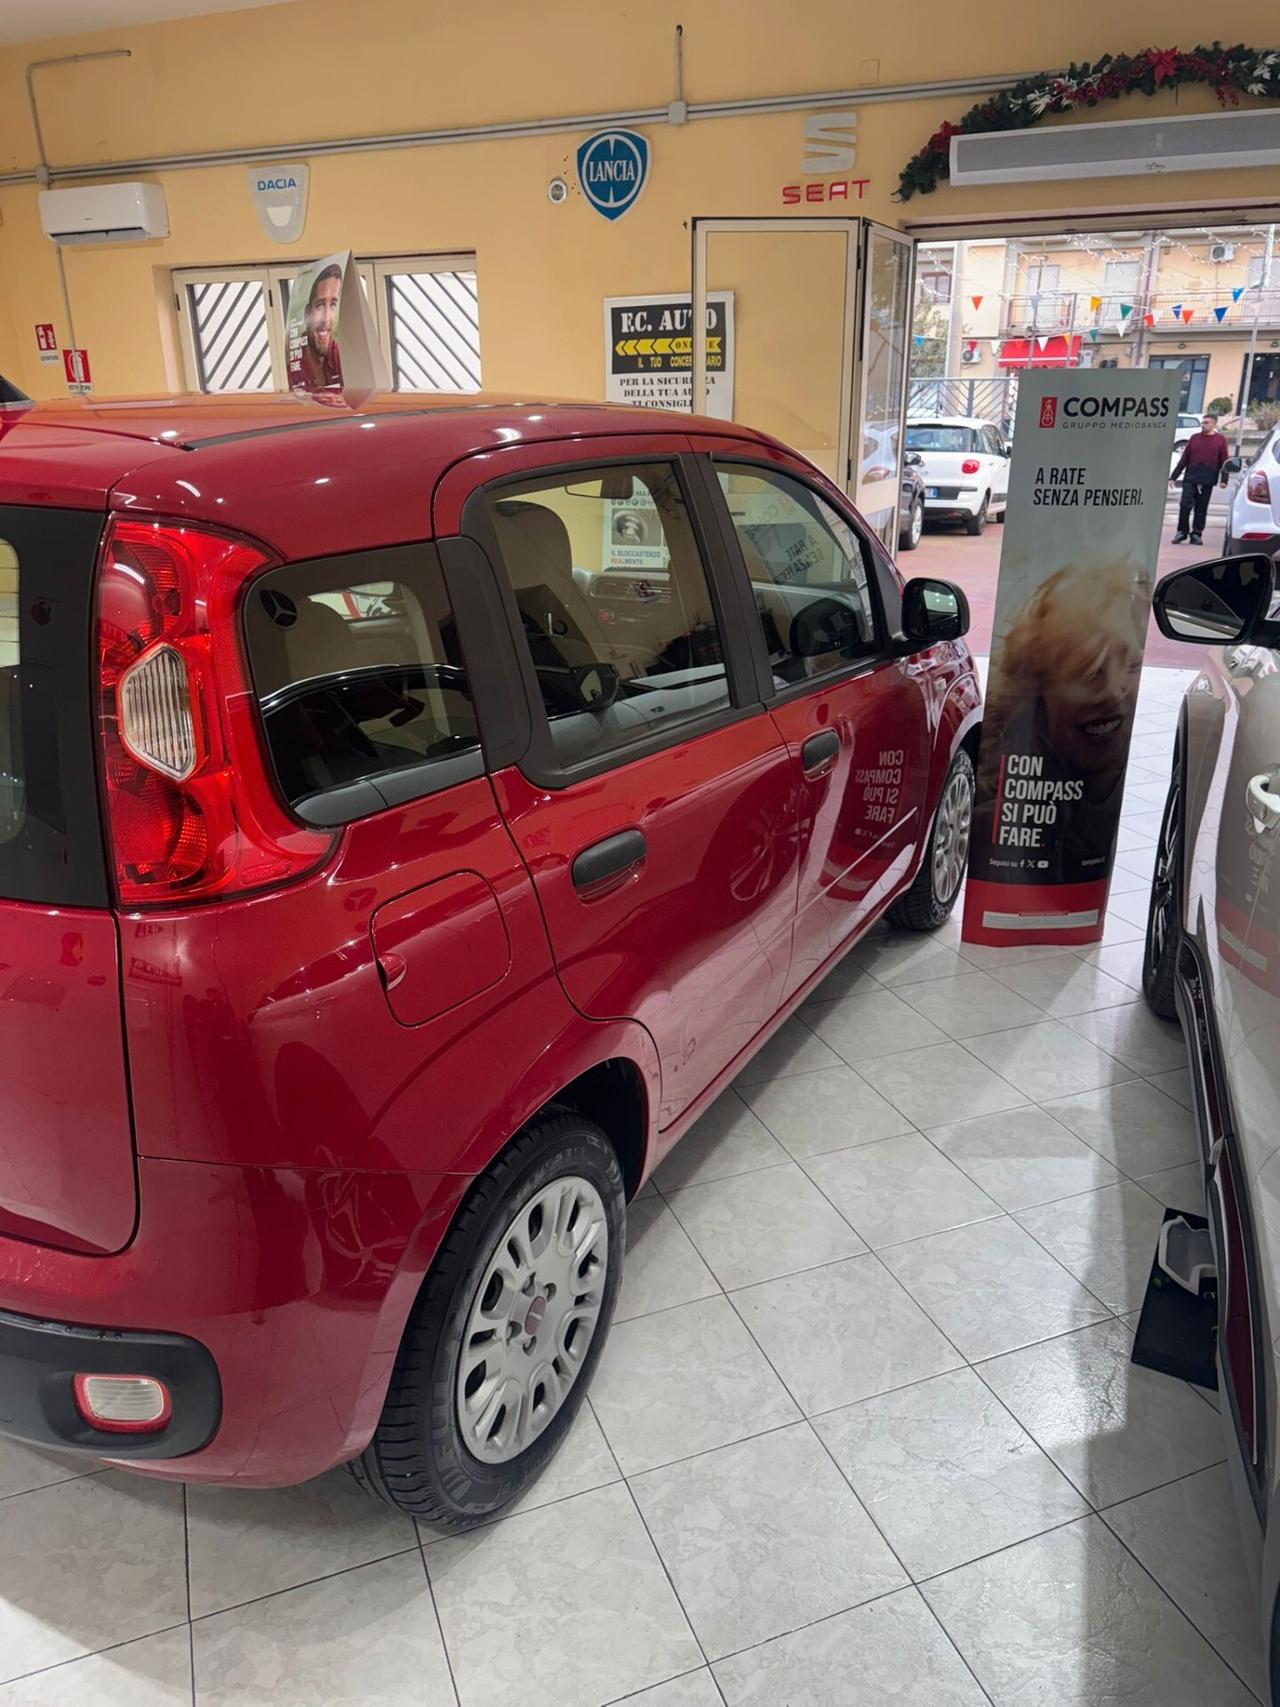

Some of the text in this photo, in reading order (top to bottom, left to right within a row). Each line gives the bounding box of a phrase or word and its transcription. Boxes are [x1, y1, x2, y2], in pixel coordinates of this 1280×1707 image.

[589, 160, 636, 182] LANCIA
[257, 178, 297, 191] DACIA
[782, 179, 871, 205] SEAT
[620, 308, 718, 333] F.C. AUO
[620, 378, 639, 387] PER
[642, 377, 654, 386] LA
[624, 389, 655, 398] DELLA
[658, 388, 679, 397] TUA
[1063, 396, 1170, 418] COMPASS
[1062, 421, 1167, 430] GRUPPO MEDIOBANCA
[1035, 467, 1087, 485] A RATE
[1033, 488, 1144, 506] SENZA PENSIERI.
[1007, 754, 1044, 777] CON
[1004, 778, 1084, 801] COMPASS
[1001, 800, 1058, 825] SI PUÒ
